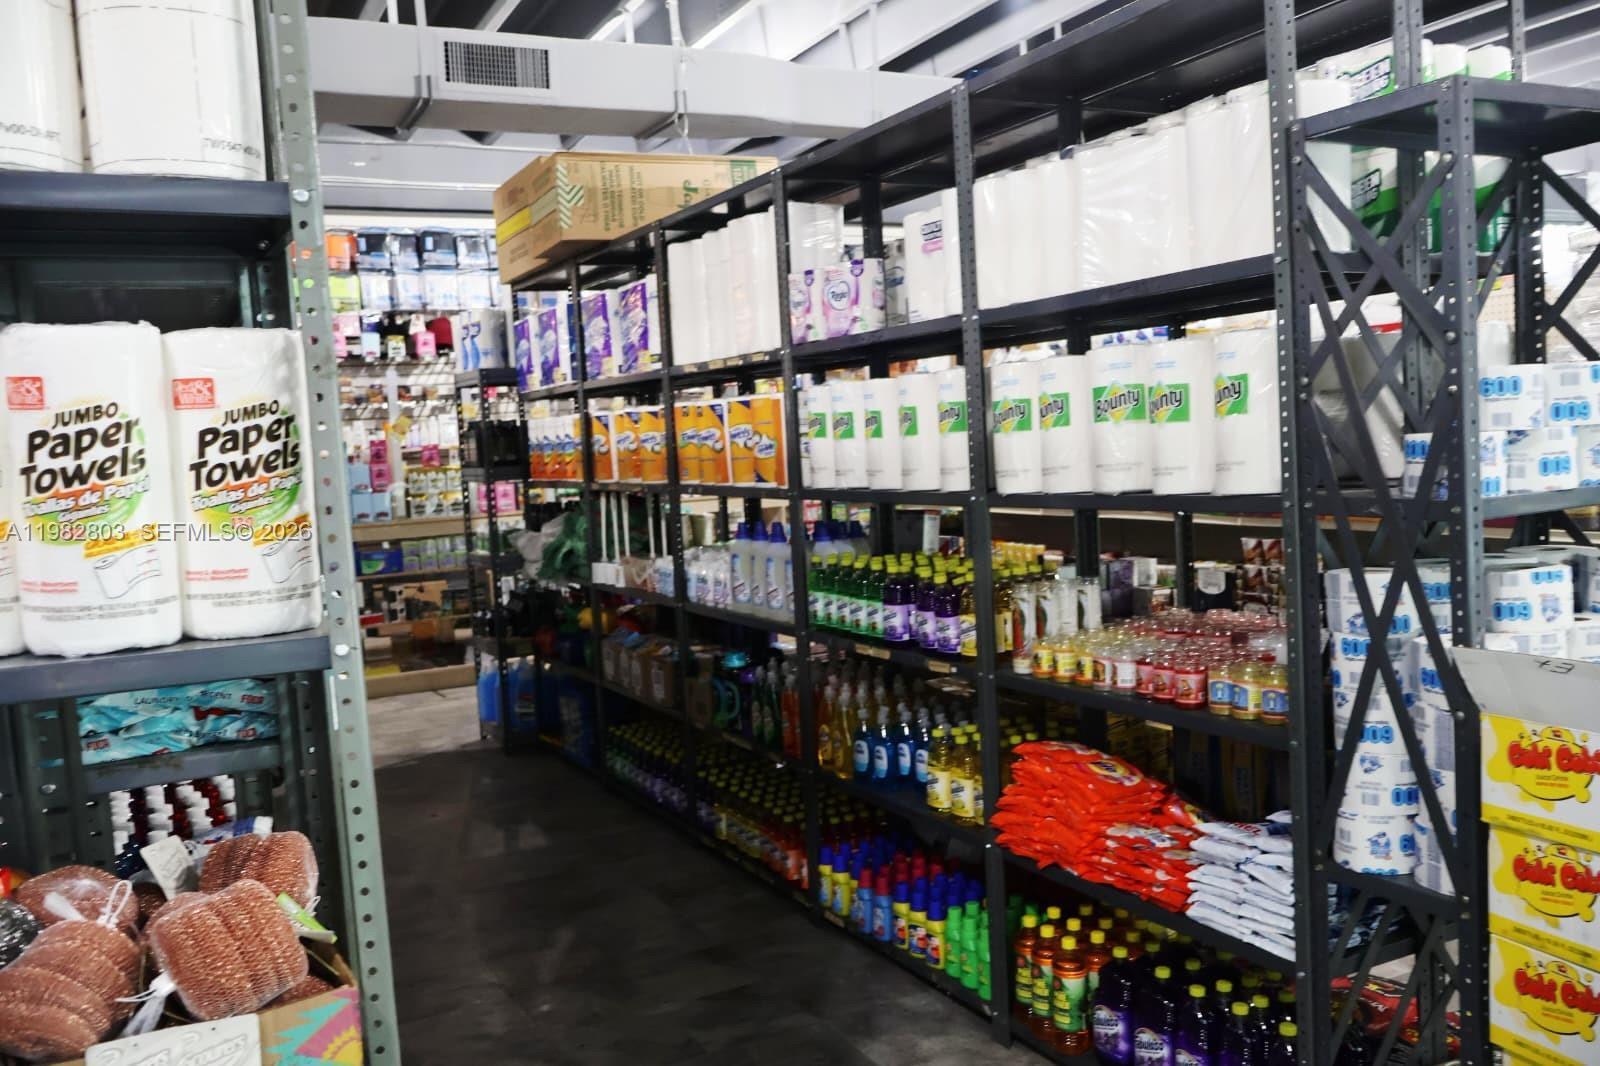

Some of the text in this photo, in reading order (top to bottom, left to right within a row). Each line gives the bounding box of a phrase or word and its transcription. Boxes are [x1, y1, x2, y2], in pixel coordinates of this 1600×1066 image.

[52, 402, 119, 429] JUMBO
[222, 400, 280, 427] JUMBO
[1096, 388, 1141, 419] Bounty
[28, 418, 140, 464] Paper
[198, 414, 296, 460] Paper
[20, 447, 146, 497] Towels
[189, 440, 301, 491] Towels
